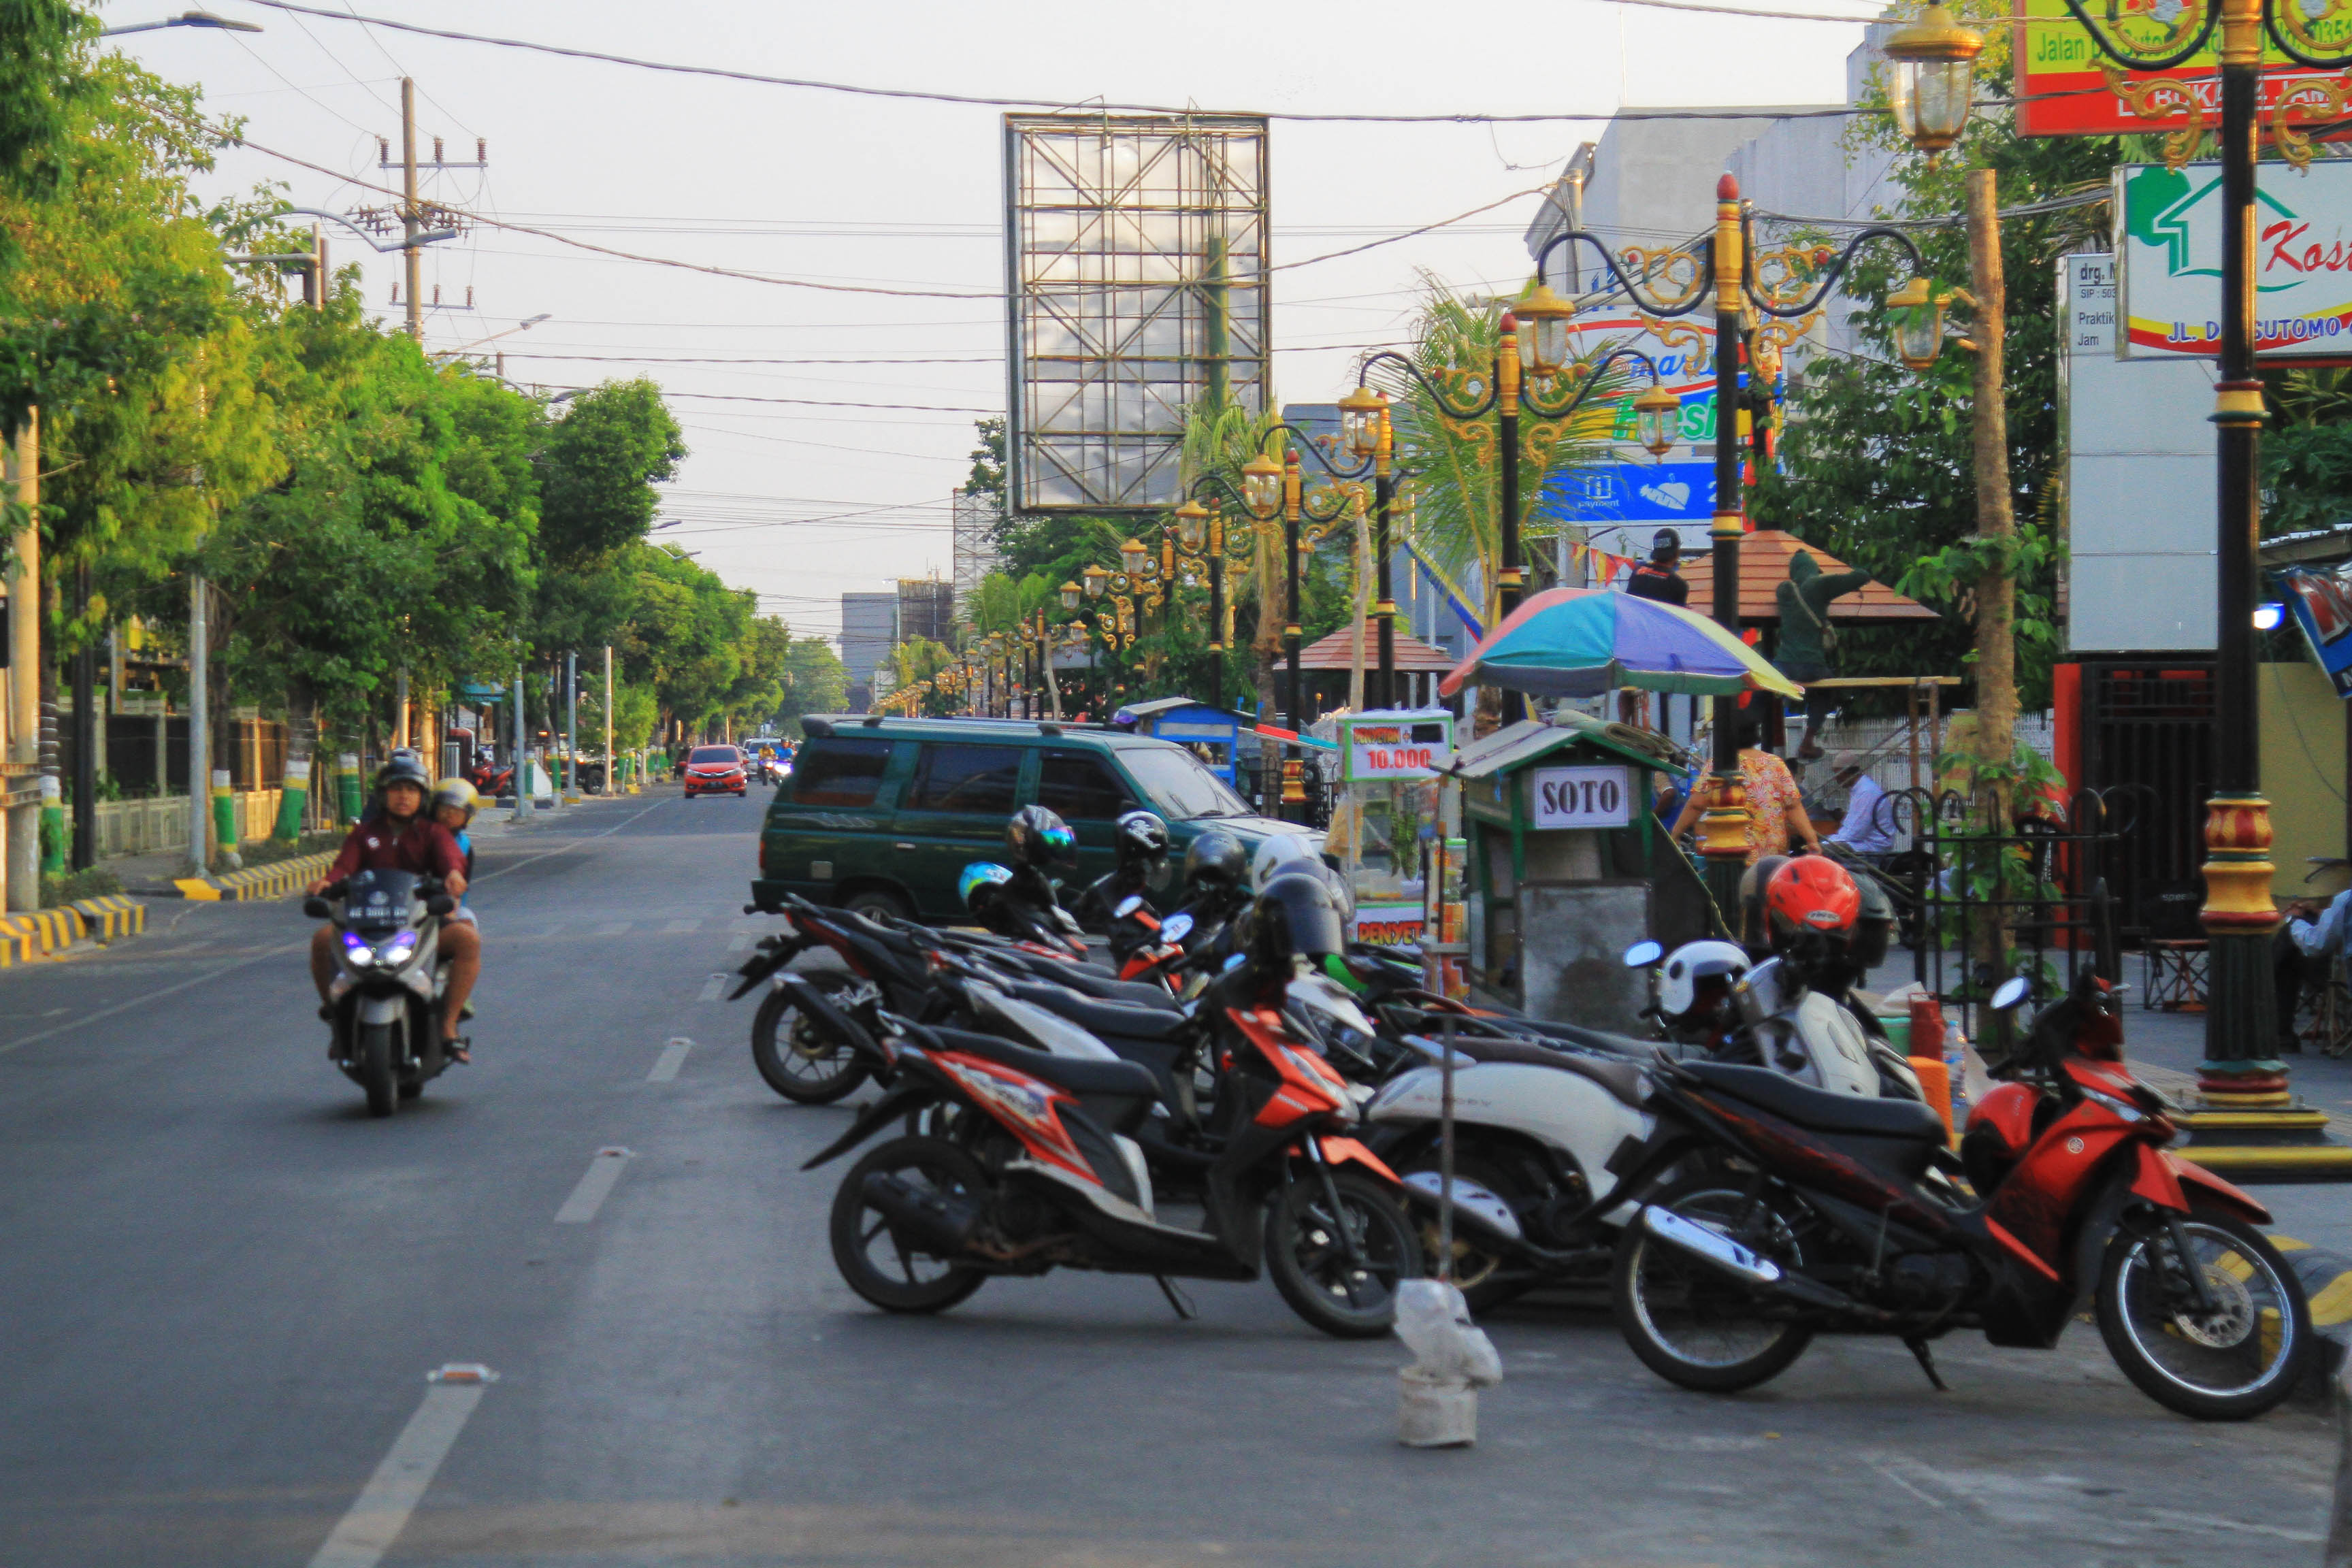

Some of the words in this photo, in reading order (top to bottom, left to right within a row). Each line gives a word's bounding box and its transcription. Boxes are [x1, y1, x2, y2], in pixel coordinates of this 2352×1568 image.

[2037, 31, 2085, 62] Jalan
[2080, 263, 2105, 284] drg.
[2080, 289, 2095, 298] SIP
[2078, 311, 2114, 325] Praktik
[2078, 333, 2100, 346] Jam
[2168, 321, 2198, 342] JL.
[2255, 316, 2342, 341] SUTOMO
[1367, 748, 1432, 770] 10.000
[1541, 779, 1620, 816] SOTO
